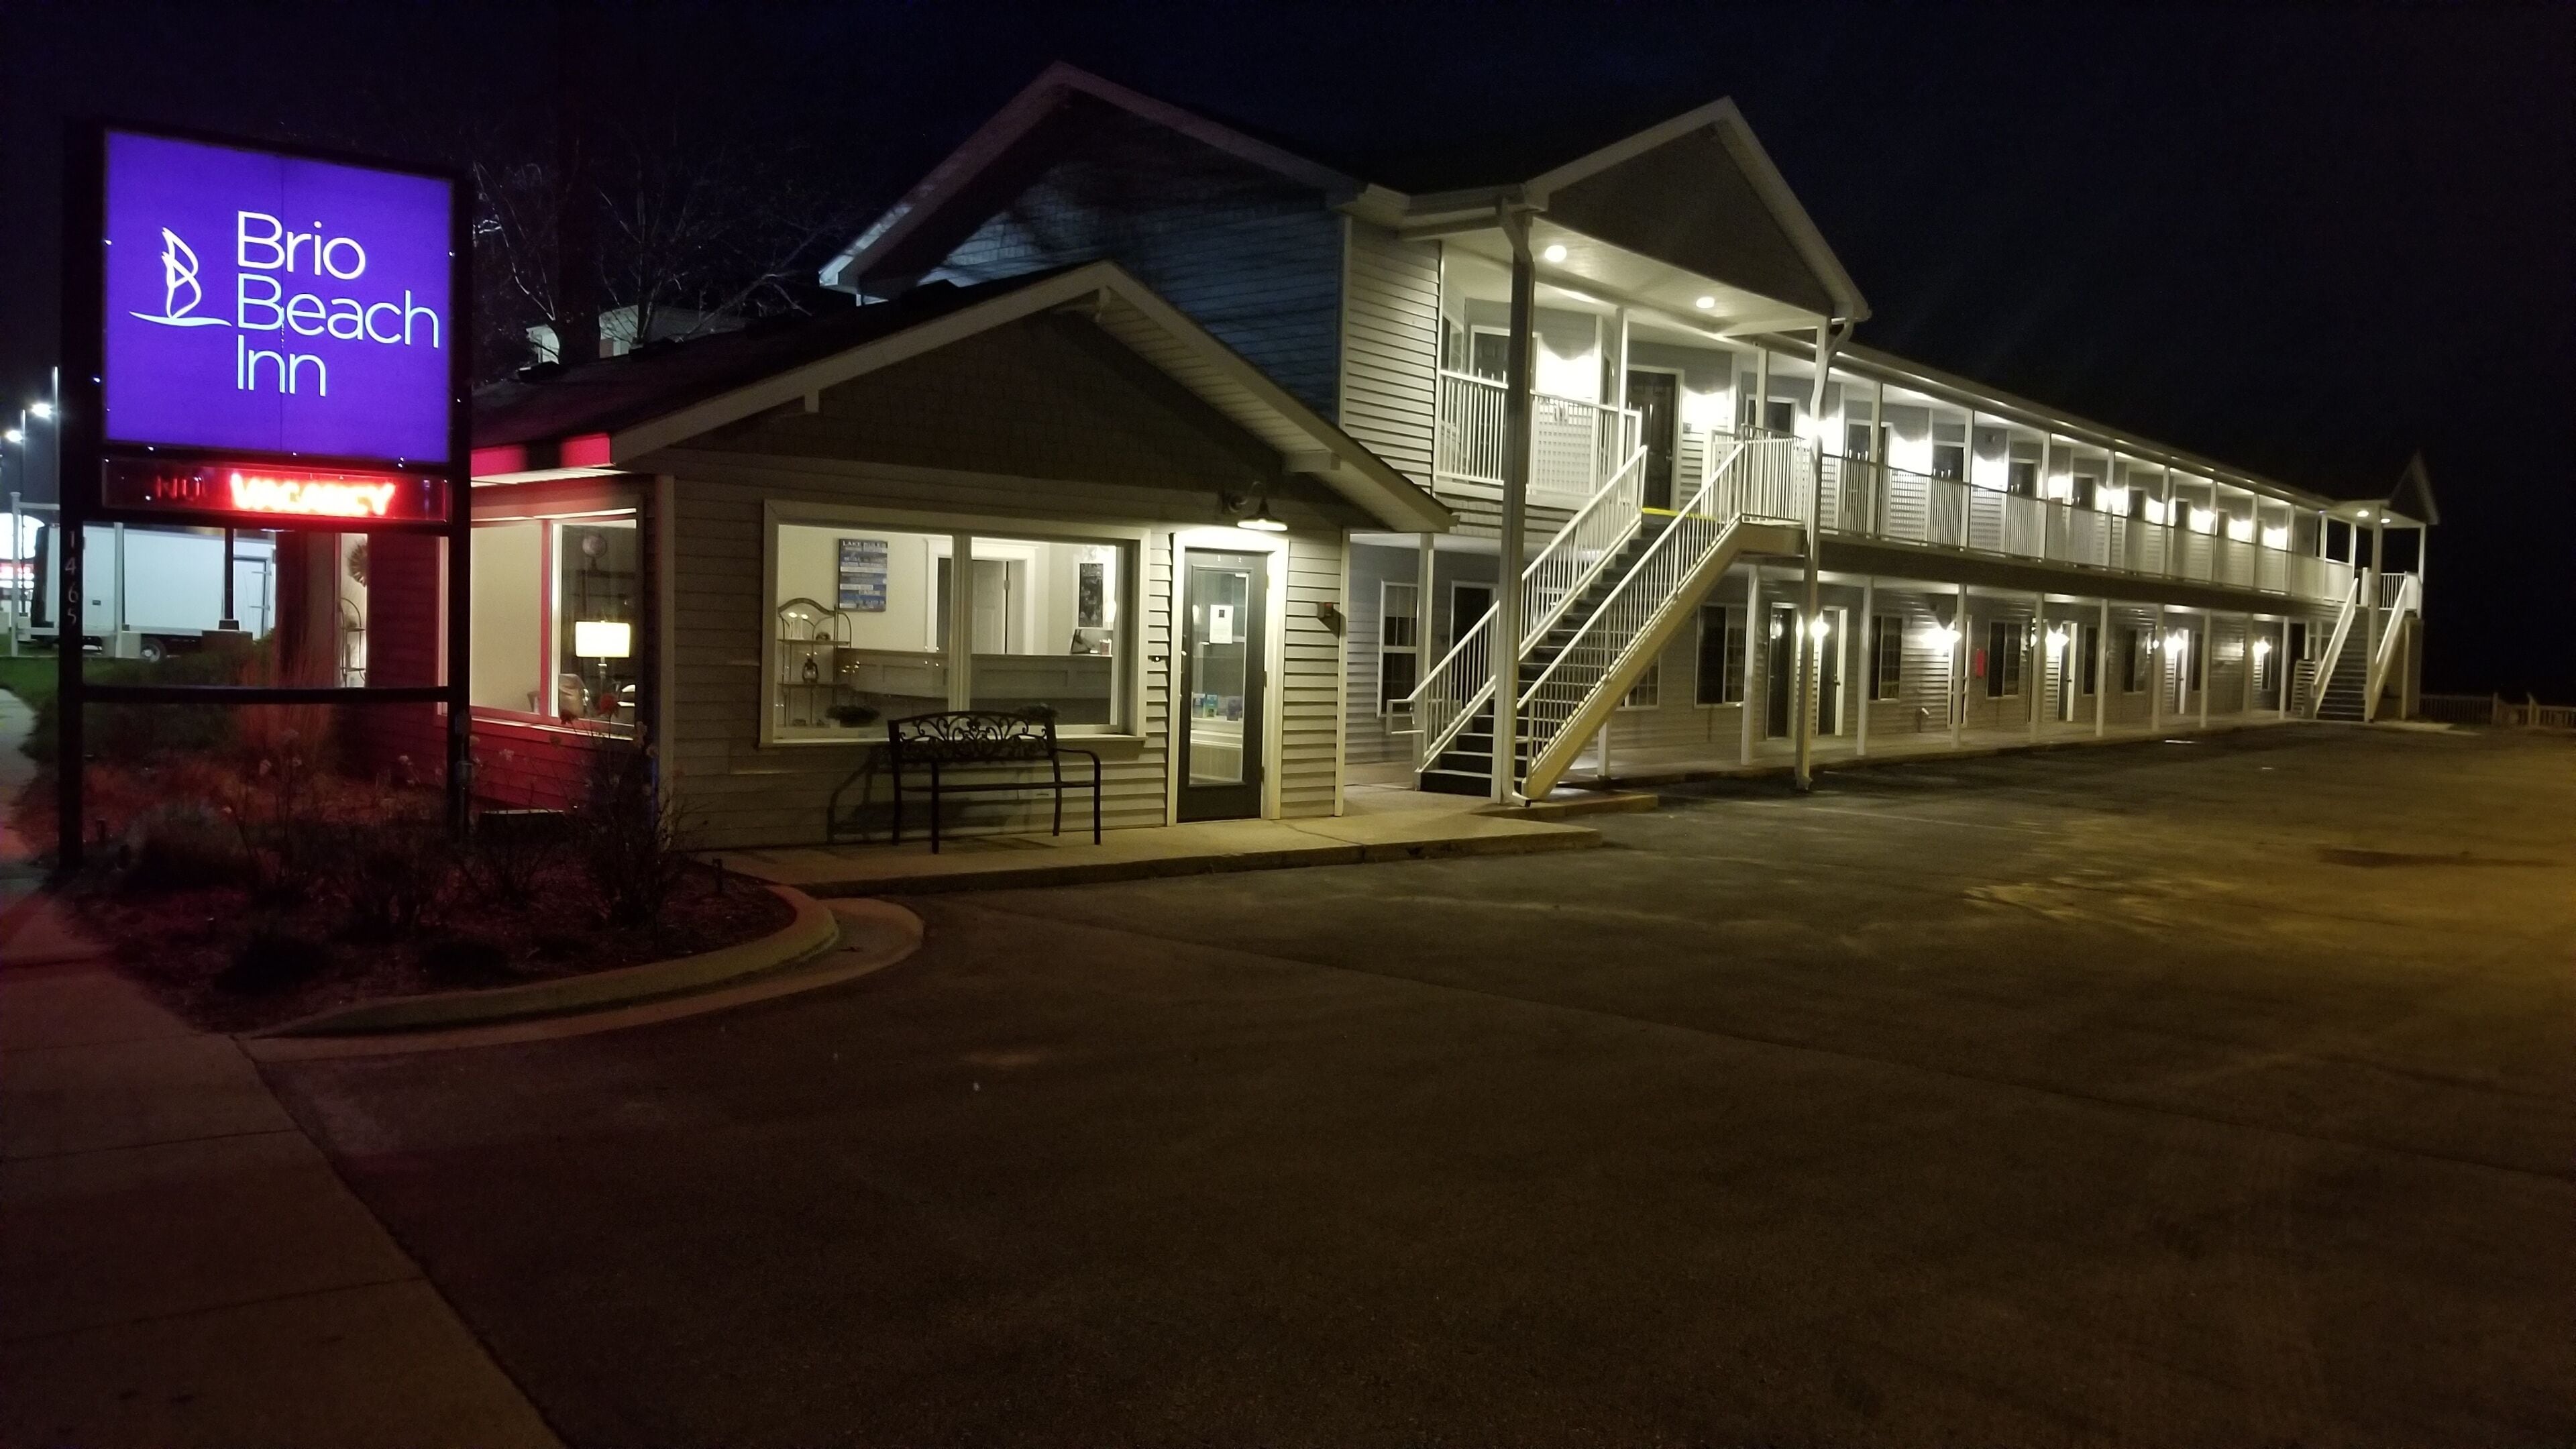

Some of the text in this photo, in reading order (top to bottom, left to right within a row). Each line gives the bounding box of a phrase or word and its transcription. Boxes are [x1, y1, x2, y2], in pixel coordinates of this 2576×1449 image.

[237, 211, 366, 280] Brio
[237, 272, 439, 349] Beach
[237, 334, 327, 397] Inn
[230, 472, 396, 516] VACANCY
[65, 531, 78, 625] 1465
